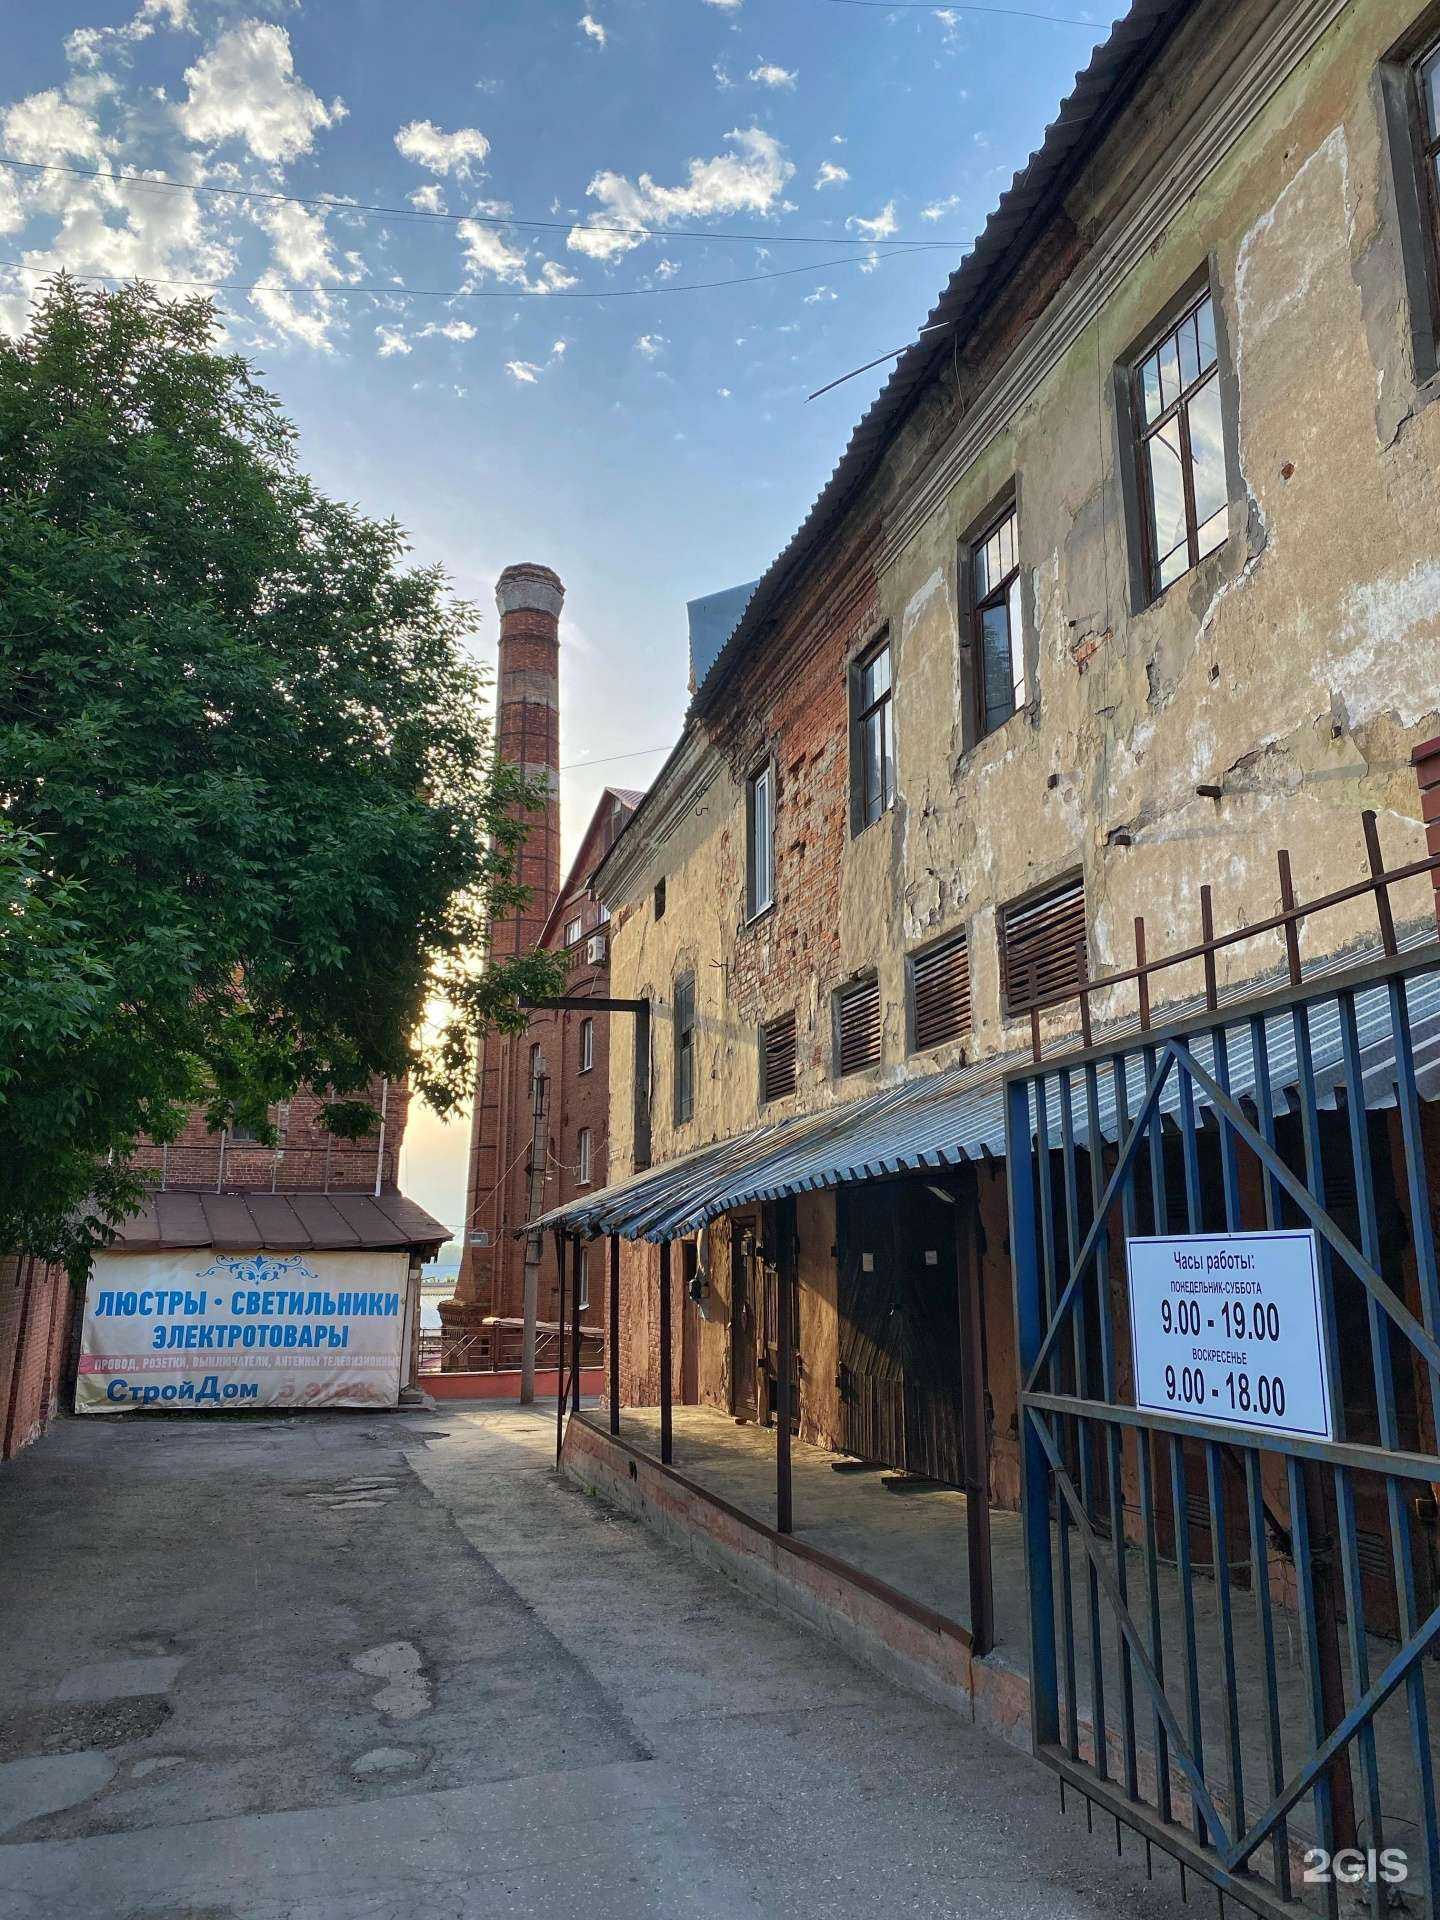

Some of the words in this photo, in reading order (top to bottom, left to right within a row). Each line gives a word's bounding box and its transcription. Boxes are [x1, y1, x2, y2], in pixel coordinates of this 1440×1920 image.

[1173, 1251, 1203, 1270] Часы
[1206, 1250, 1255, 1273] работы:
[1170, 1280, 1262, 1295] ПОНЕДЕЛЬНИК-СУББОТА
[95, 1291, 207, 1317] ЛЮСТРЫ
[231, 1291, 399, 1316] СВЕТИЛЬНИКИ
[1161, 1299, 1201, 1336] 9.00
[1221, 1301, 1280, 1342] 19.00
[152, 1325, 349, 1349] ЭЛЕКТРОТОВАРЫ
[1192, 1348, 1248, 1365] ВОСКРЕСЕНЬЕ
[106, 1375, 258, 1405] СтройДом
[1164, 1365, 1206, 1405] 9.00
[1226, 1371, 1286, 1417] 18.00
